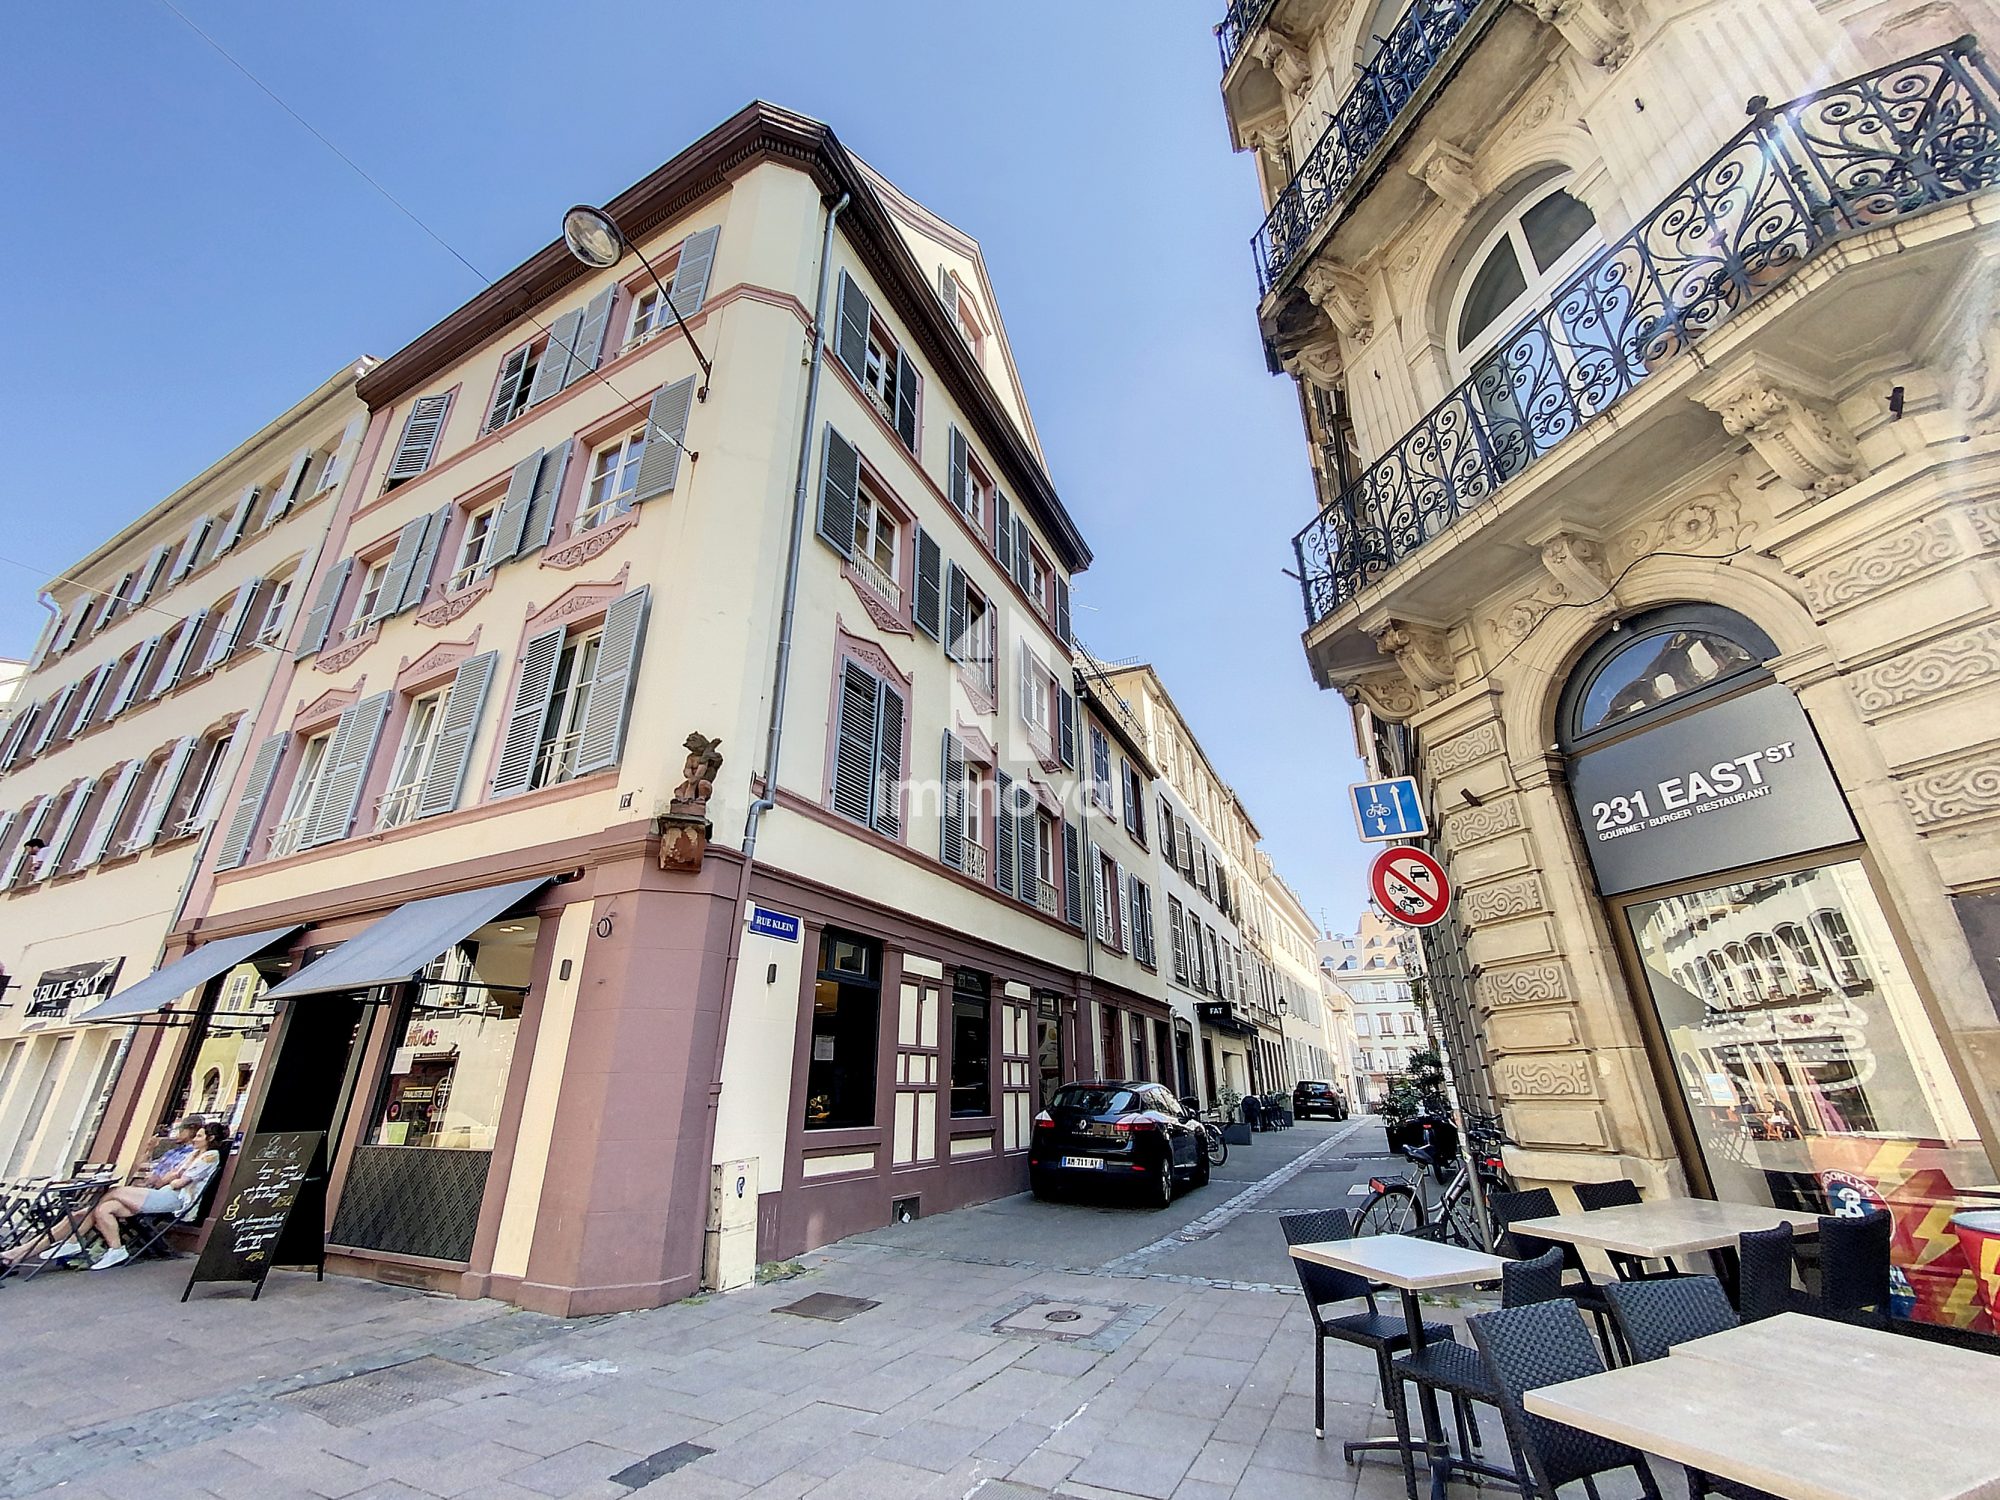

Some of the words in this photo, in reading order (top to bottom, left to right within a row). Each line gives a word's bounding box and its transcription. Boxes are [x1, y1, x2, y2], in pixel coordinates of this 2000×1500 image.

[1592, 790, 1651, 831] 231
[1658, 751, 1764, 811] EAST
[1765, 741, 1795, 764] ST
[1599, 821, 1648, 842] GOURMET
[1648, 808, 1693, 828] BURGER
[1695, 785, 1772, 814] RESTAURANT
[755, 914, 772, 927] RUE
[772, 919, 795, 933] KLEIN
[38, 980, 74, 1003] BLUE
[71, 975, 106, 998] SKY
[1209, 1007, 1223, 1015] FAT
